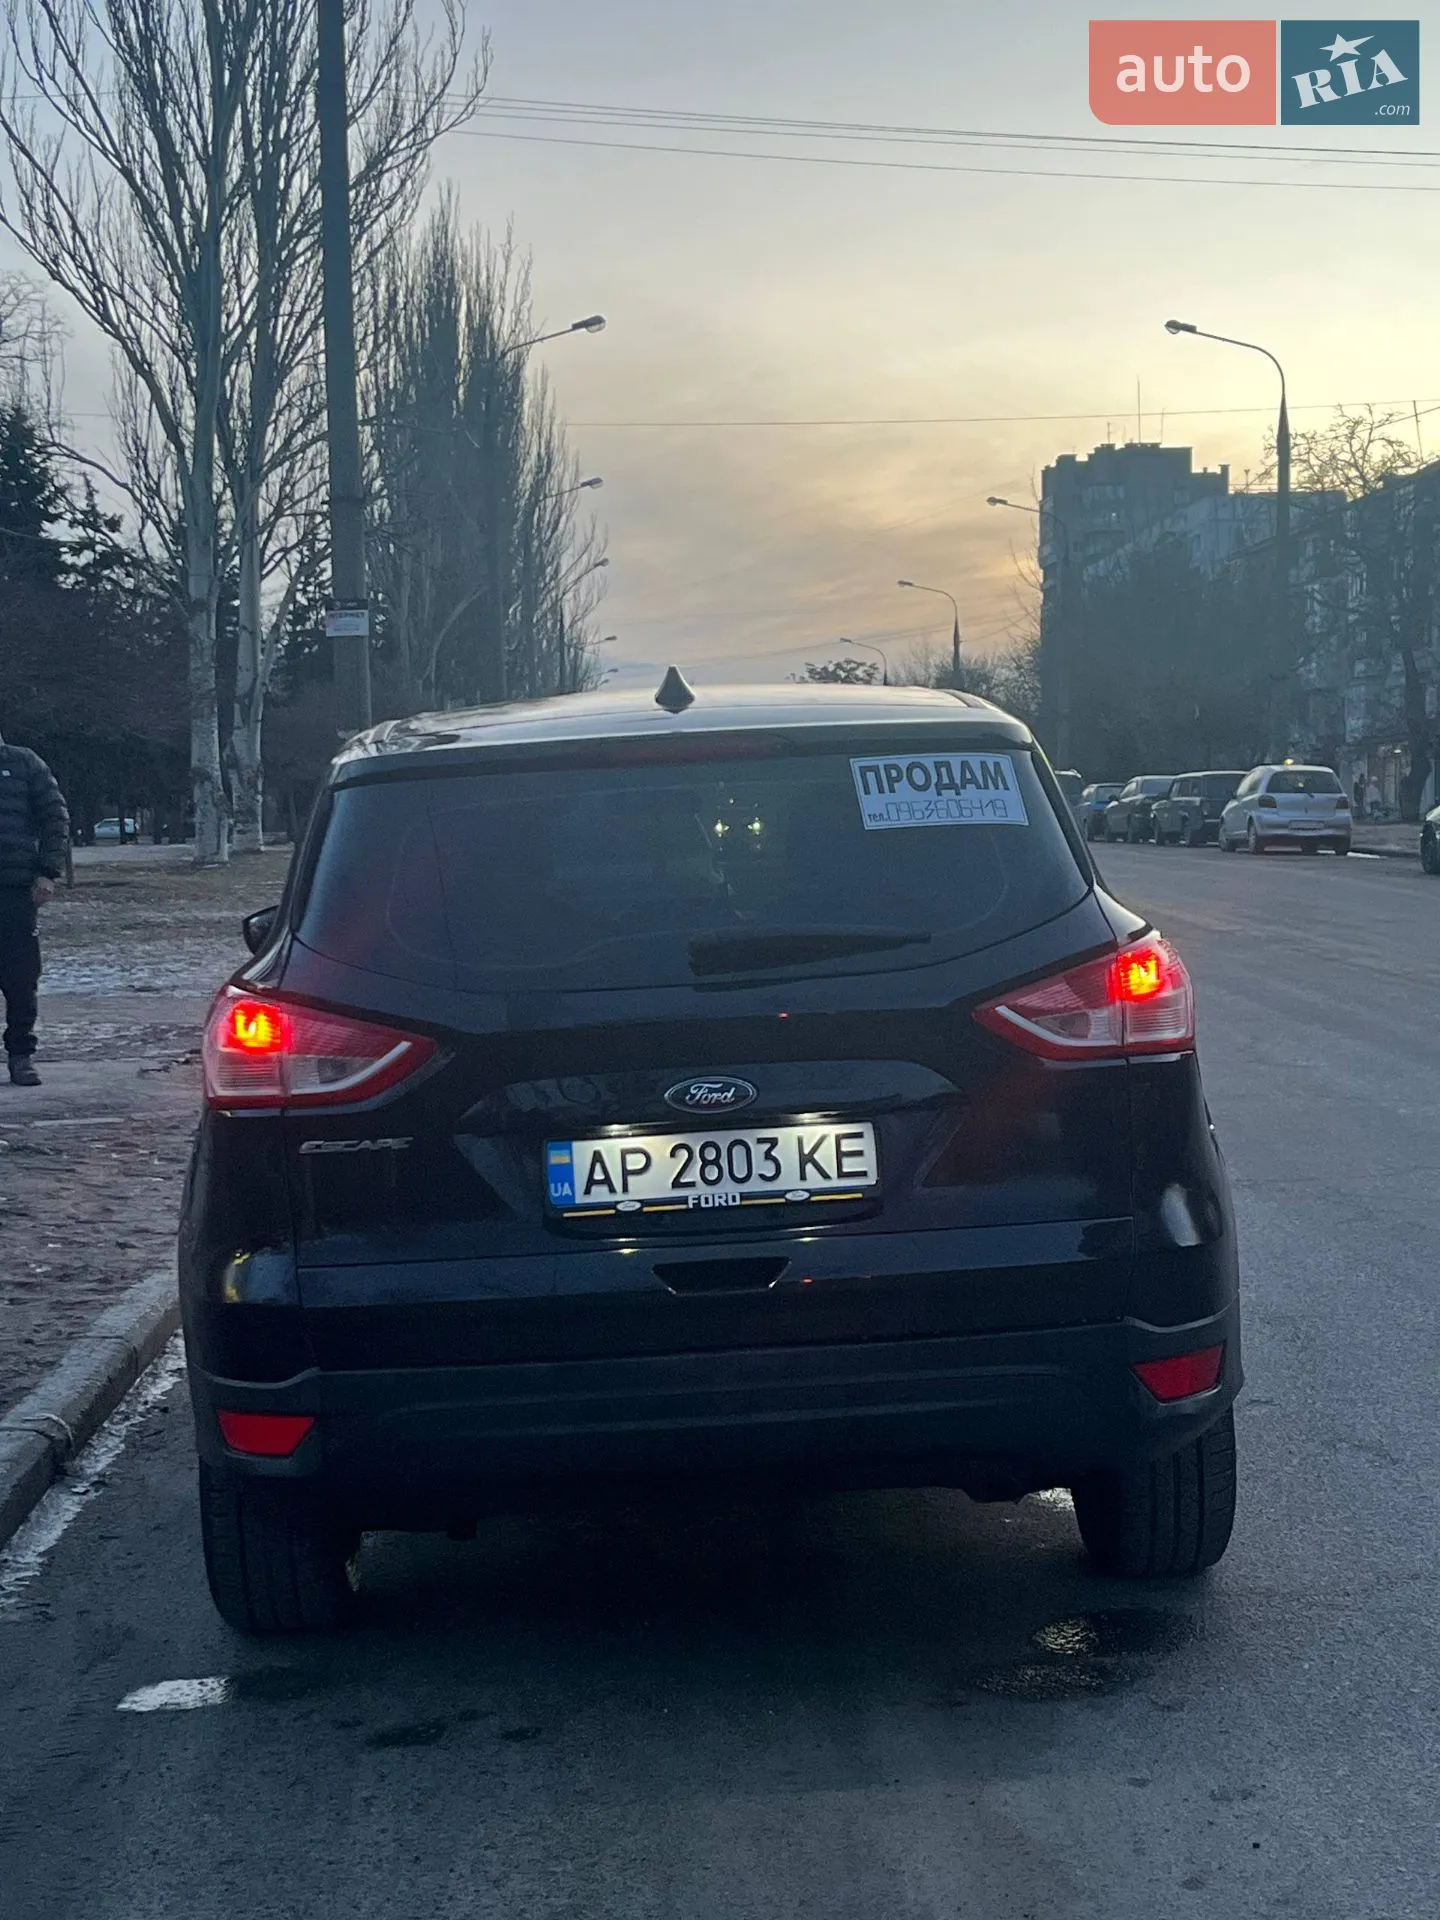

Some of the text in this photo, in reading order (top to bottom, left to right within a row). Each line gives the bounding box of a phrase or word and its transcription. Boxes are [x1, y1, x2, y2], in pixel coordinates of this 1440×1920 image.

[858, 760, 1010, 796] ПРОДАМ
[685, 1083, 735, 1105] Ford
[583, 1132, 868, 1195] AP 2803 KE
[551, 1182, 572, 1198] UA
[687, 1192, 741, 1208] FORD
